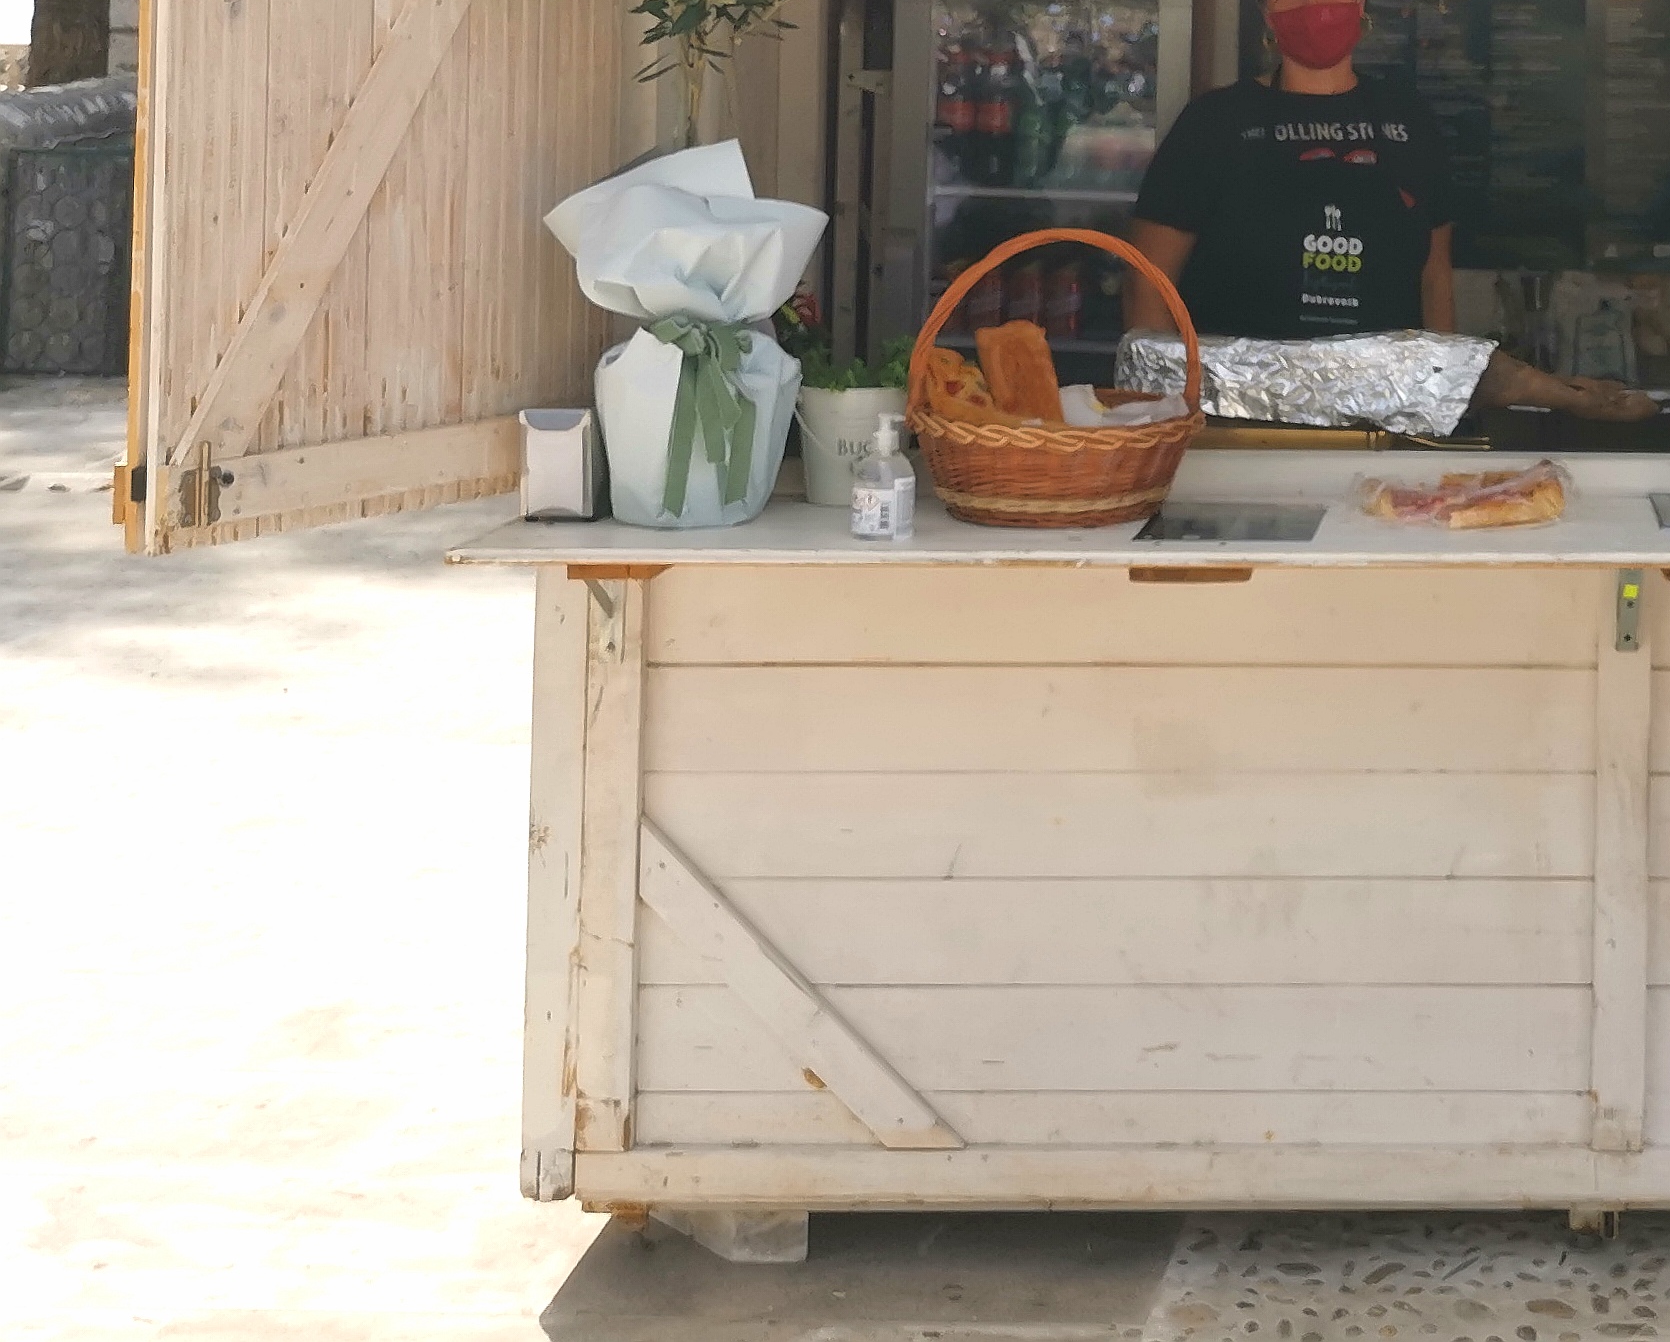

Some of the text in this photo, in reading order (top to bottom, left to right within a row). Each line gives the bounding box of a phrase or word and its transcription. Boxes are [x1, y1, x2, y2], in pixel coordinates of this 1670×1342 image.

[1274, 122, 1343, 142] OLLING
[1303, 234, 1363, 255] GOOD
[1302, 252, 1362, 273] FOOD
